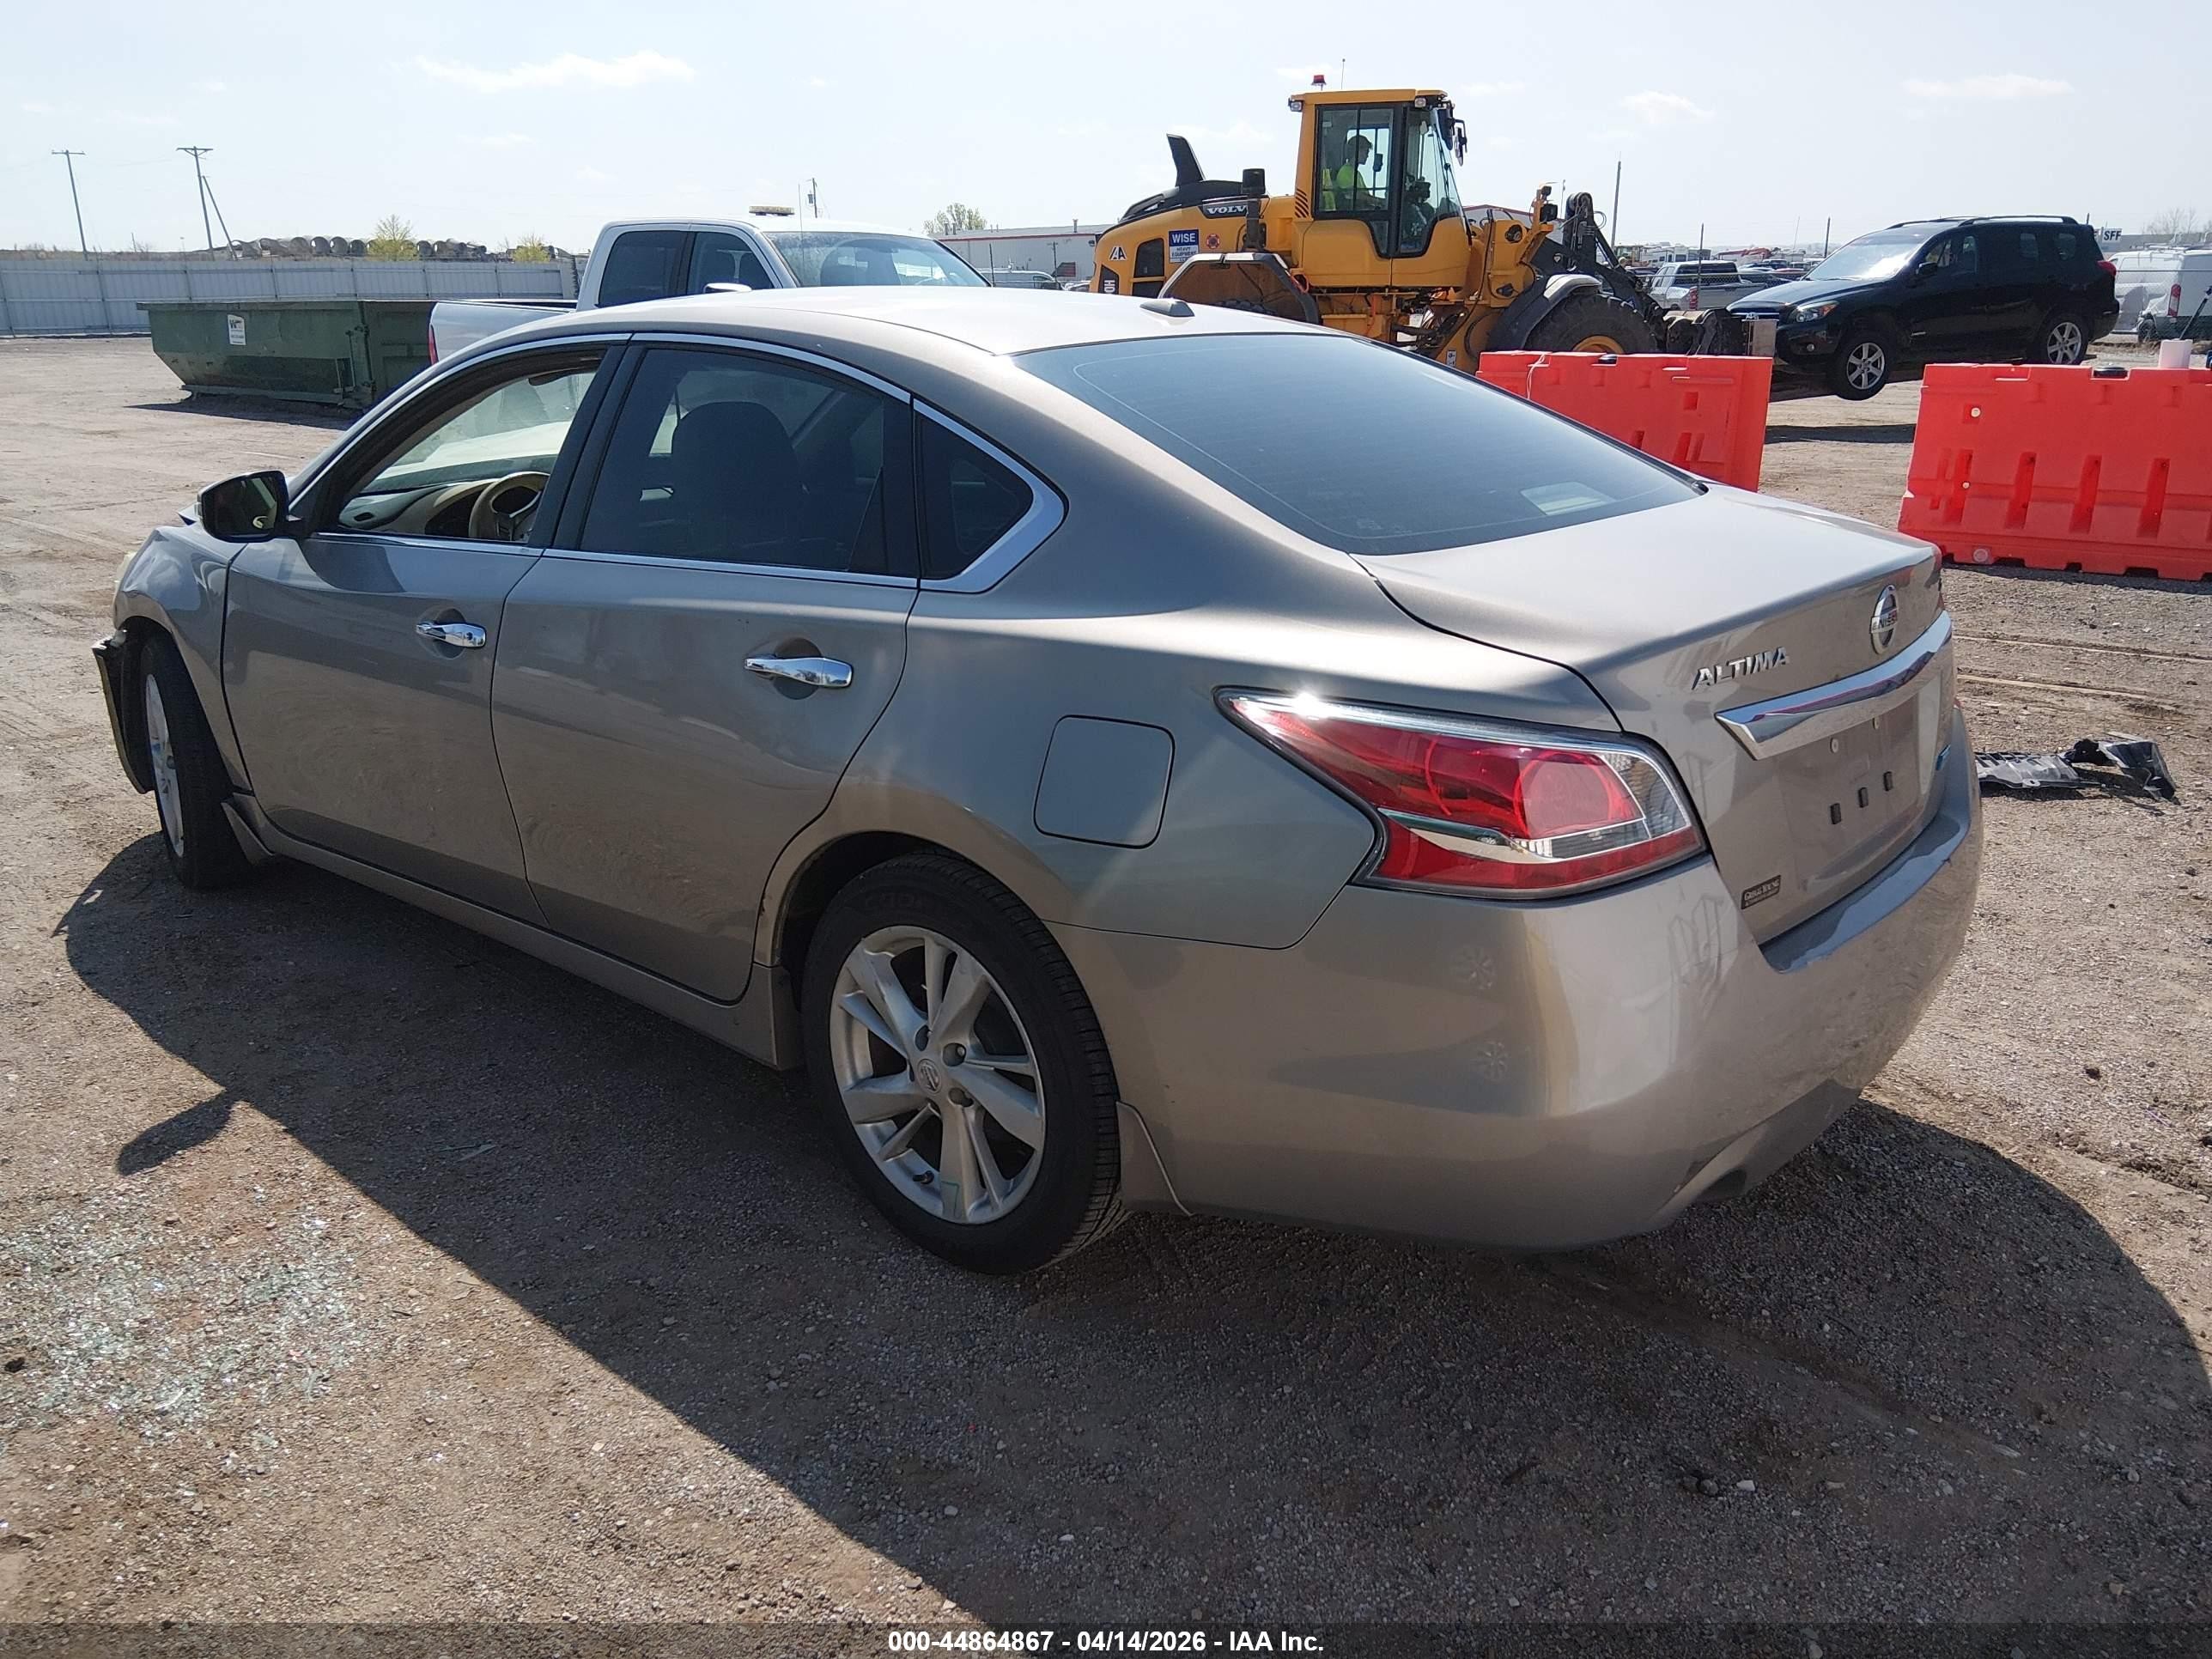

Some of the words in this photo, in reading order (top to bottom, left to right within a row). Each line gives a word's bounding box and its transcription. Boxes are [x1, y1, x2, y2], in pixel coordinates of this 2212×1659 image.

[1206, 205, 1249, 215] VOLV
[1171, 233, 1195, 243] WISE
[2104, 230, 2121, 240] SFF
[1691, 646, 1790, 690] ALTIMA
